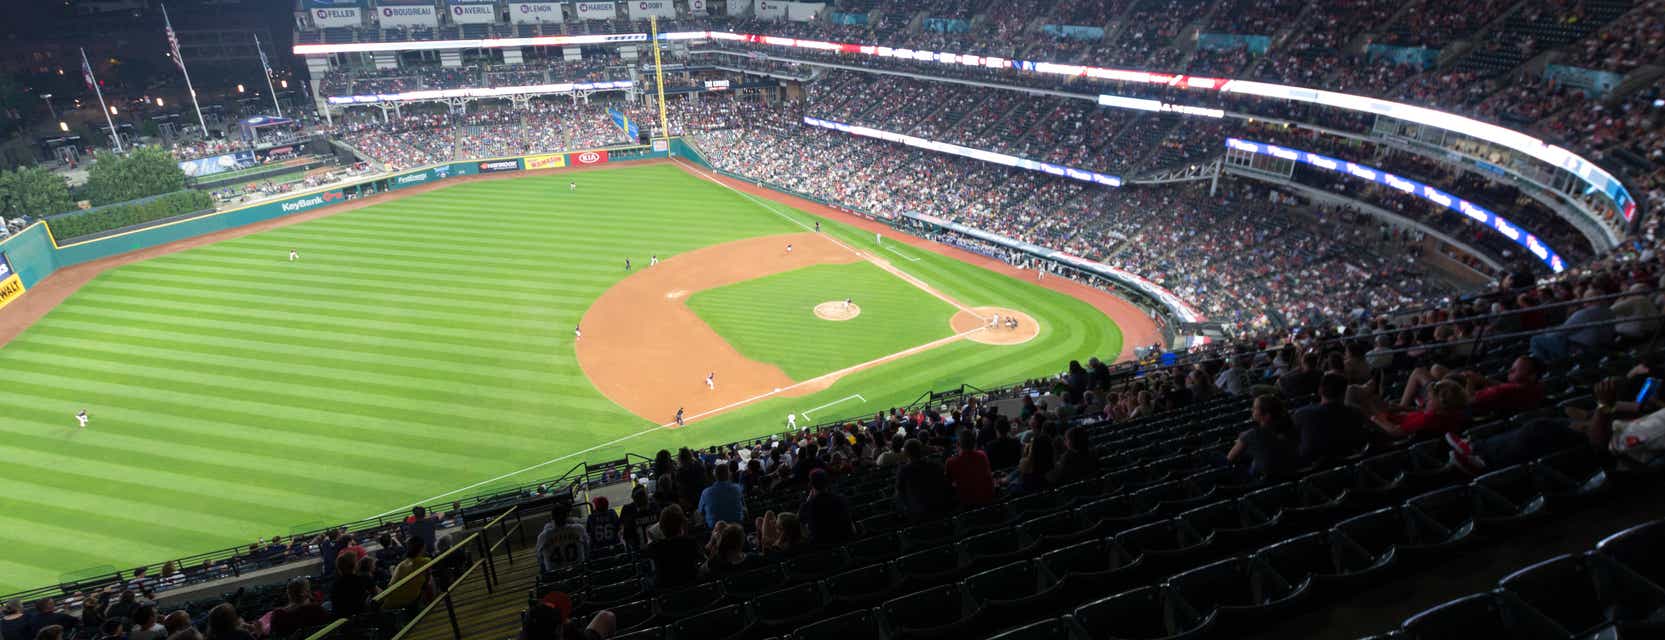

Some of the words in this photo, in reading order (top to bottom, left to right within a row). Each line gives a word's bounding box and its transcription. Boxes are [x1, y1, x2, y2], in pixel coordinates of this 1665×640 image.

[327, 9, 355, 18] FELLER
[392, 7, 431, 17] BOUDREAU
[582, 154, 597, 162] KIA
[281, 196, 323, 212] KeyBank
